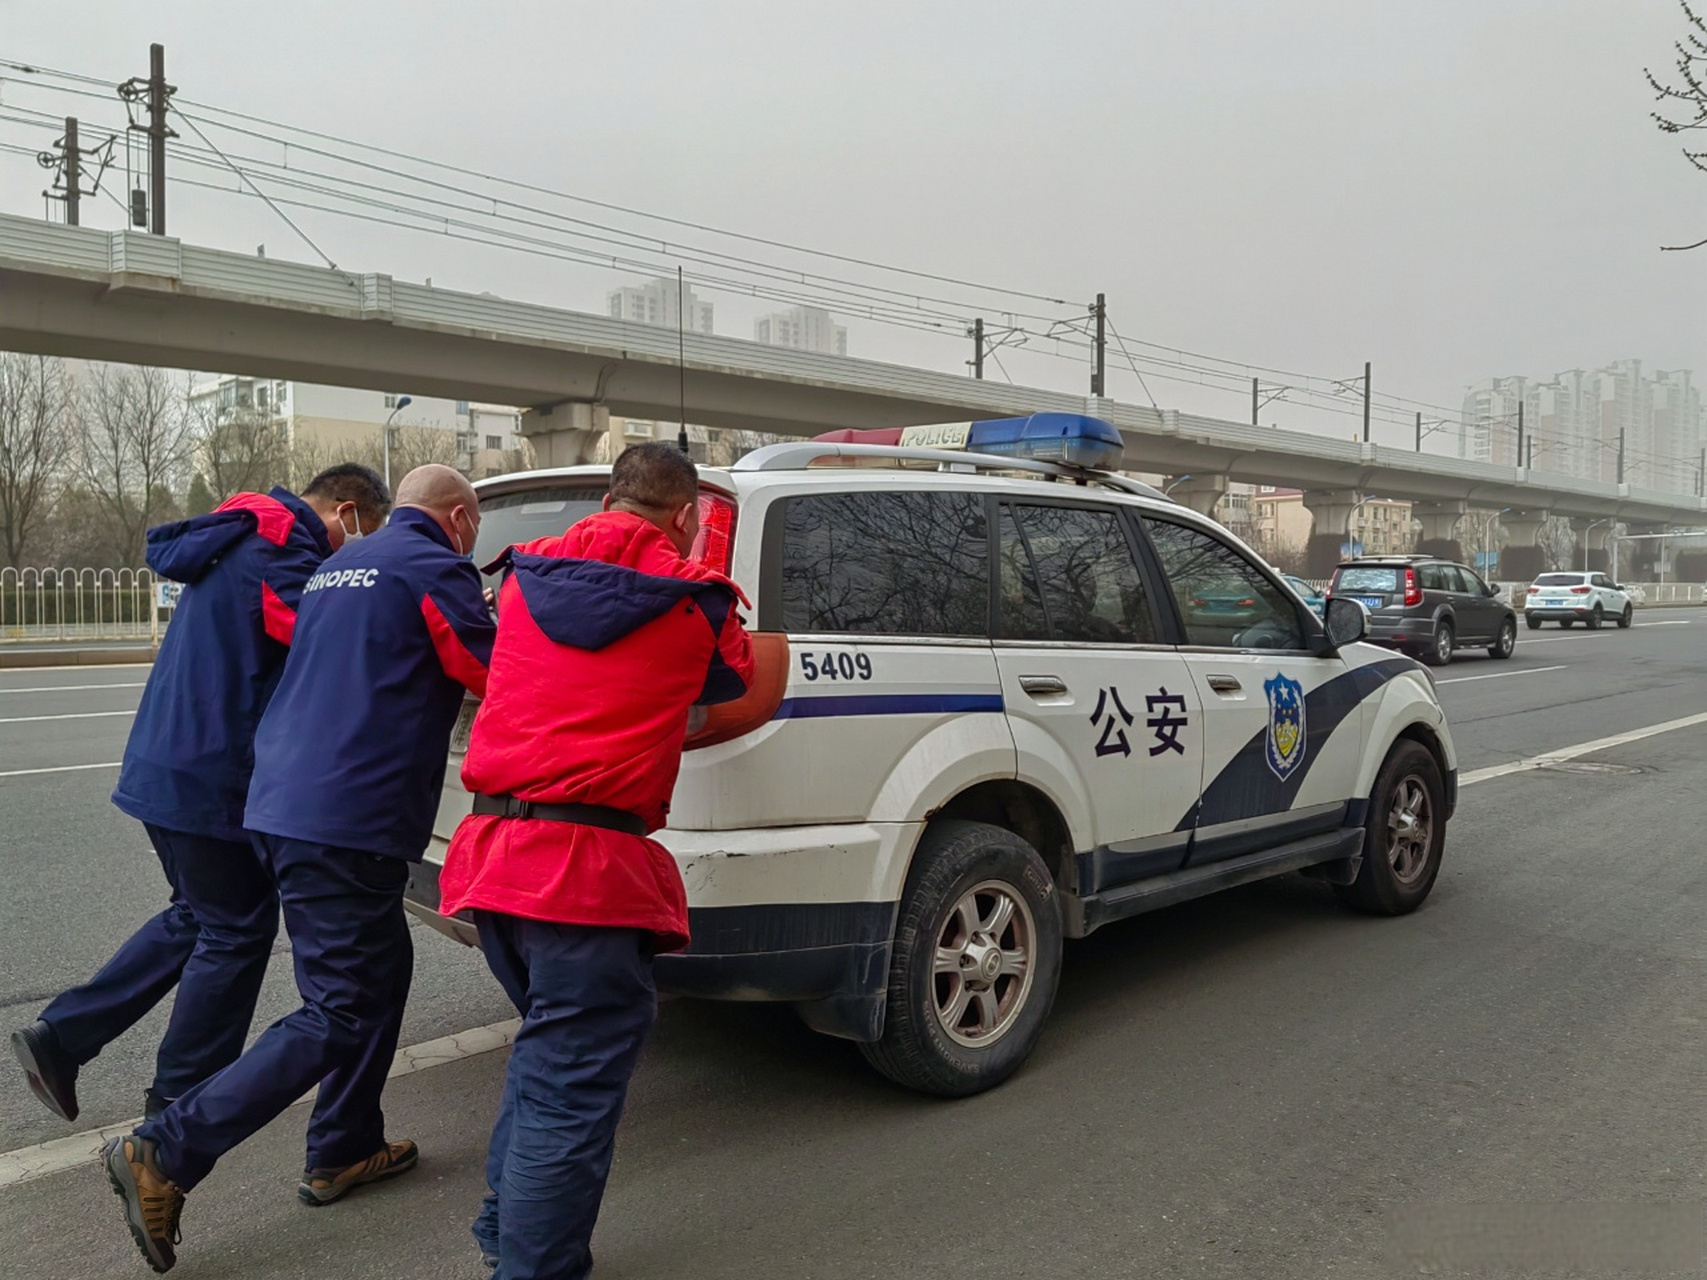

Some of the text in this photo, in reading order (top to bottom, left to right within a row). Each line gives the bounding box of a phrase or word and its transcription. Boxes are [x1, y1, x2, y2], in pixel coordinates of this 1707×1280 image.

[905, 427, 960, 446] POLICE
[800, 652, 872, 681] 5409
[1090, 686, 1188, 758] 公安
